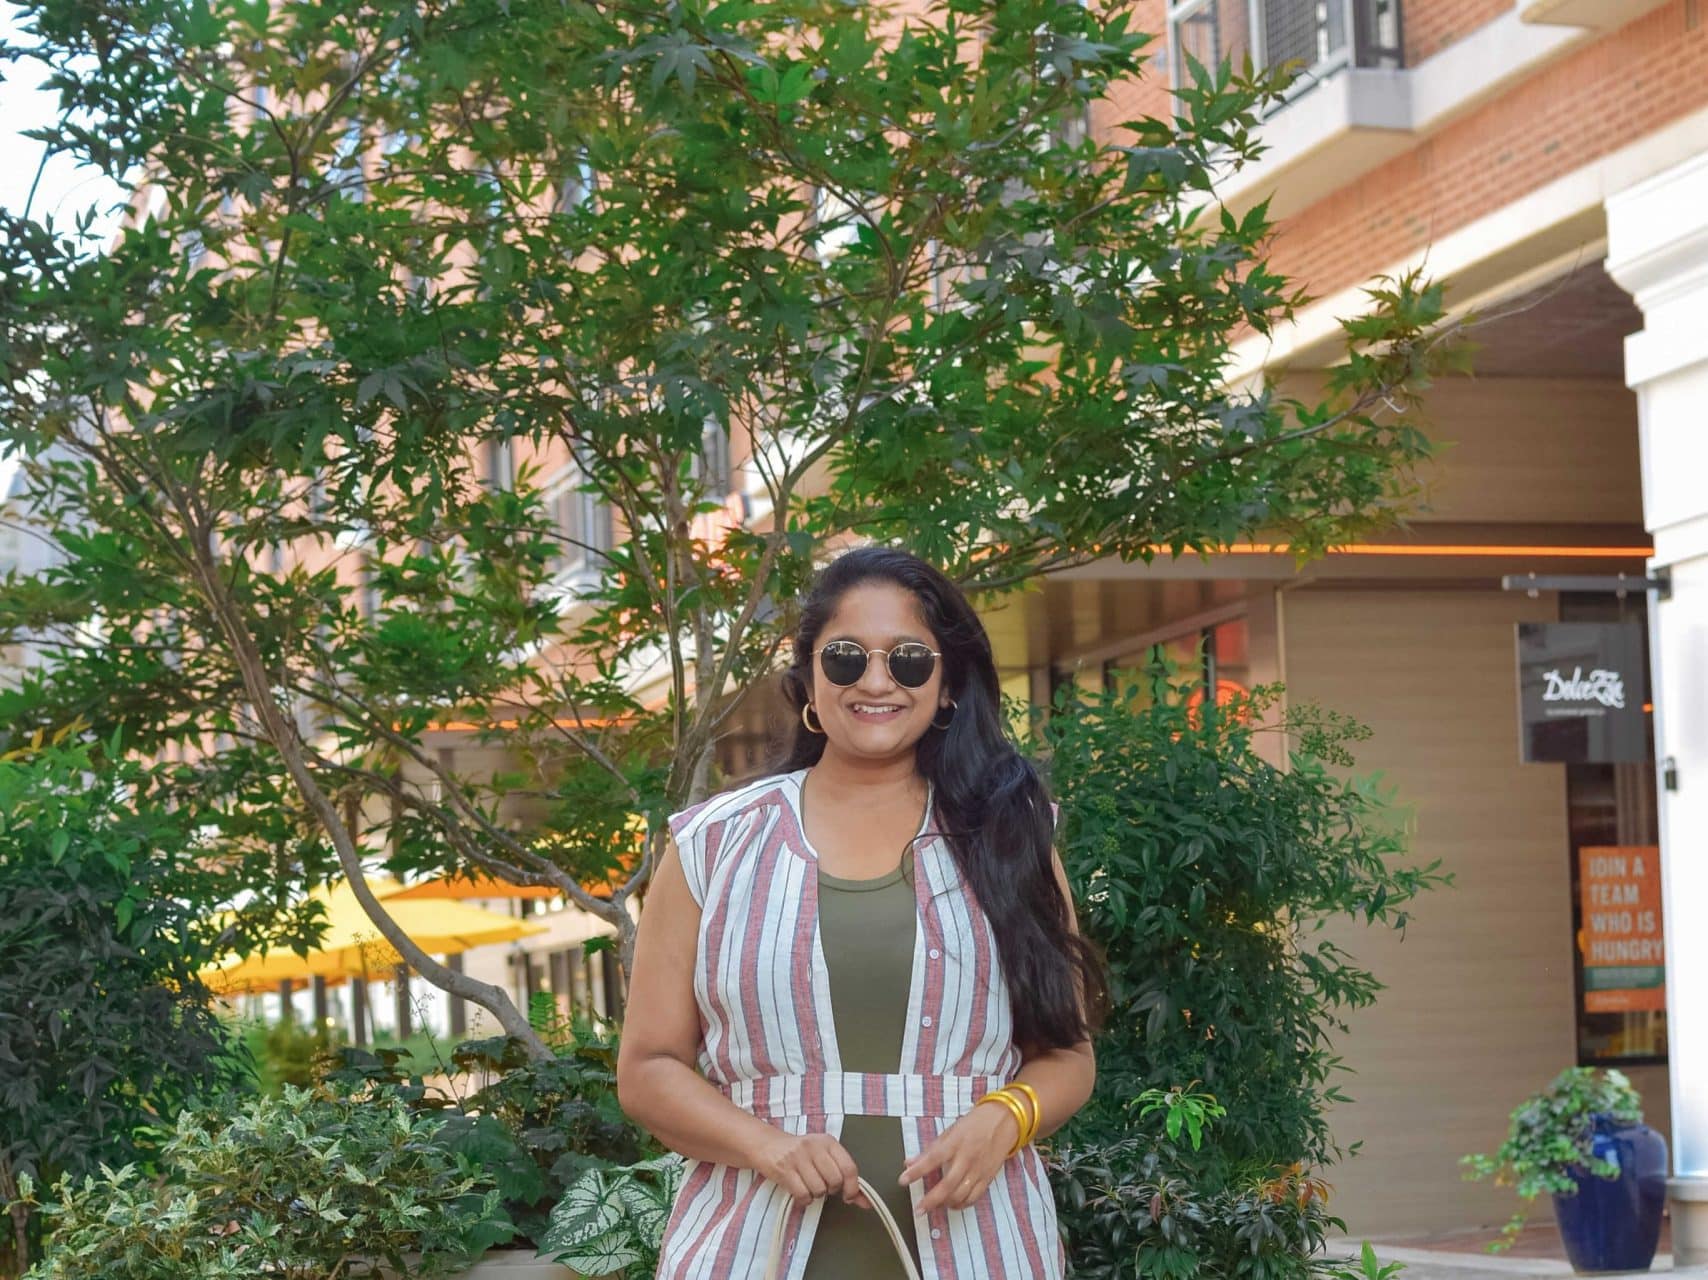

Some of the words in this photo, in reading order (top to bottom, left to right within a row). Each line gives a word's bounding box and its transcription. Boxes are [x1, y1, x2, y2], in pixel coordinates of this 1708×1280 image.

[1632, 856, 1645, 877] A
[1590, 884, 1640, 905] TEAM
[1591, 911, 1632, 933] WHO
[1637, 910, 1656, 932] IS
[1591, 938, 1664, 960] HUNGRY
